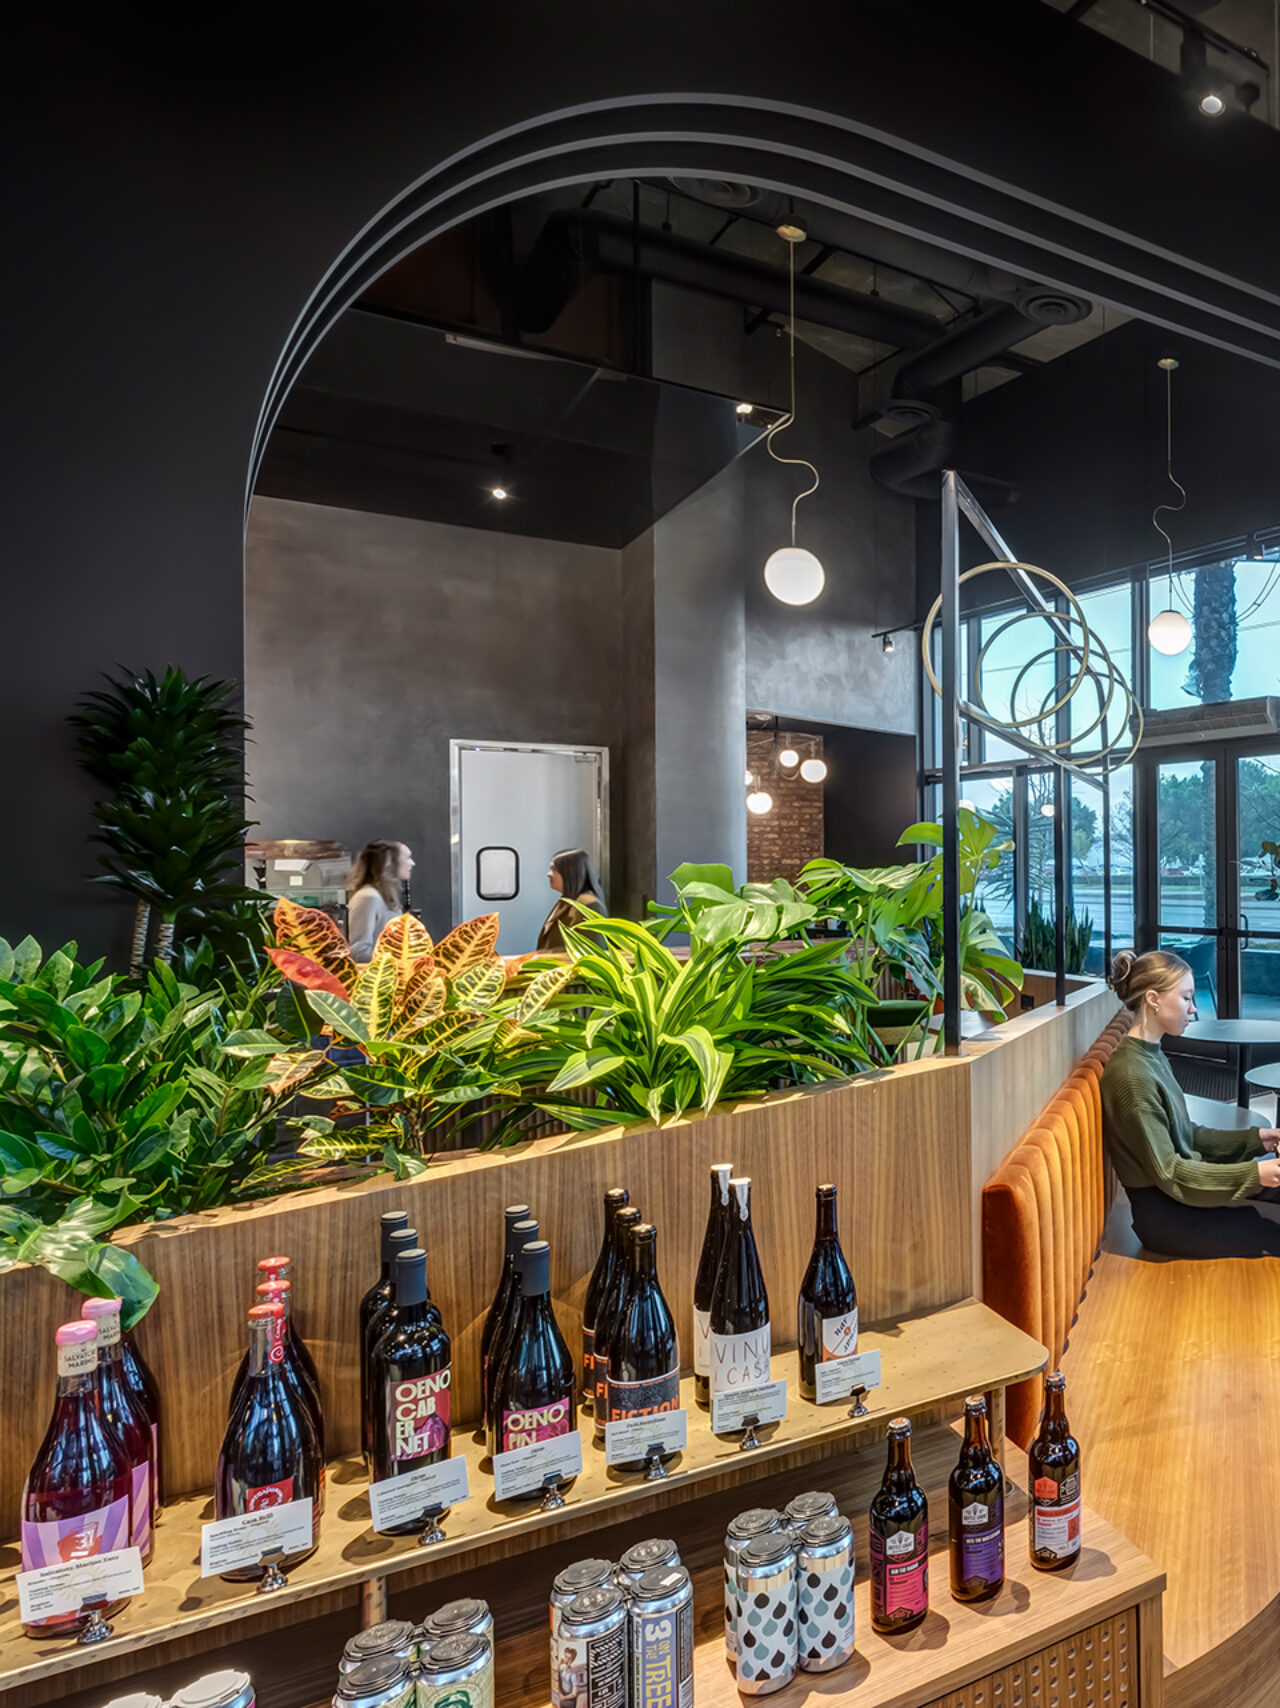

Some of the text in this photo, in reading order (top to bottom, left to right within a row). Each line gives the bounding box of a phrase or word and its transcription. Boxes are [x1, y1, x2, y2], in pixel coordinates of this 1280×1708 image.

[715, 1334, 769, 1364] VINU
[395, 1369, 451, 1402] OENO
[396, 1396, 436, 1421] CAB
[507, 1404, 565, 1431] OENO
[396, 1420, 415, 1438] ER
[396, 1431, 430, 1456] NET
[644, 1619, 672, 1642] 3
[645, 1655, 672, 1708] TREE
